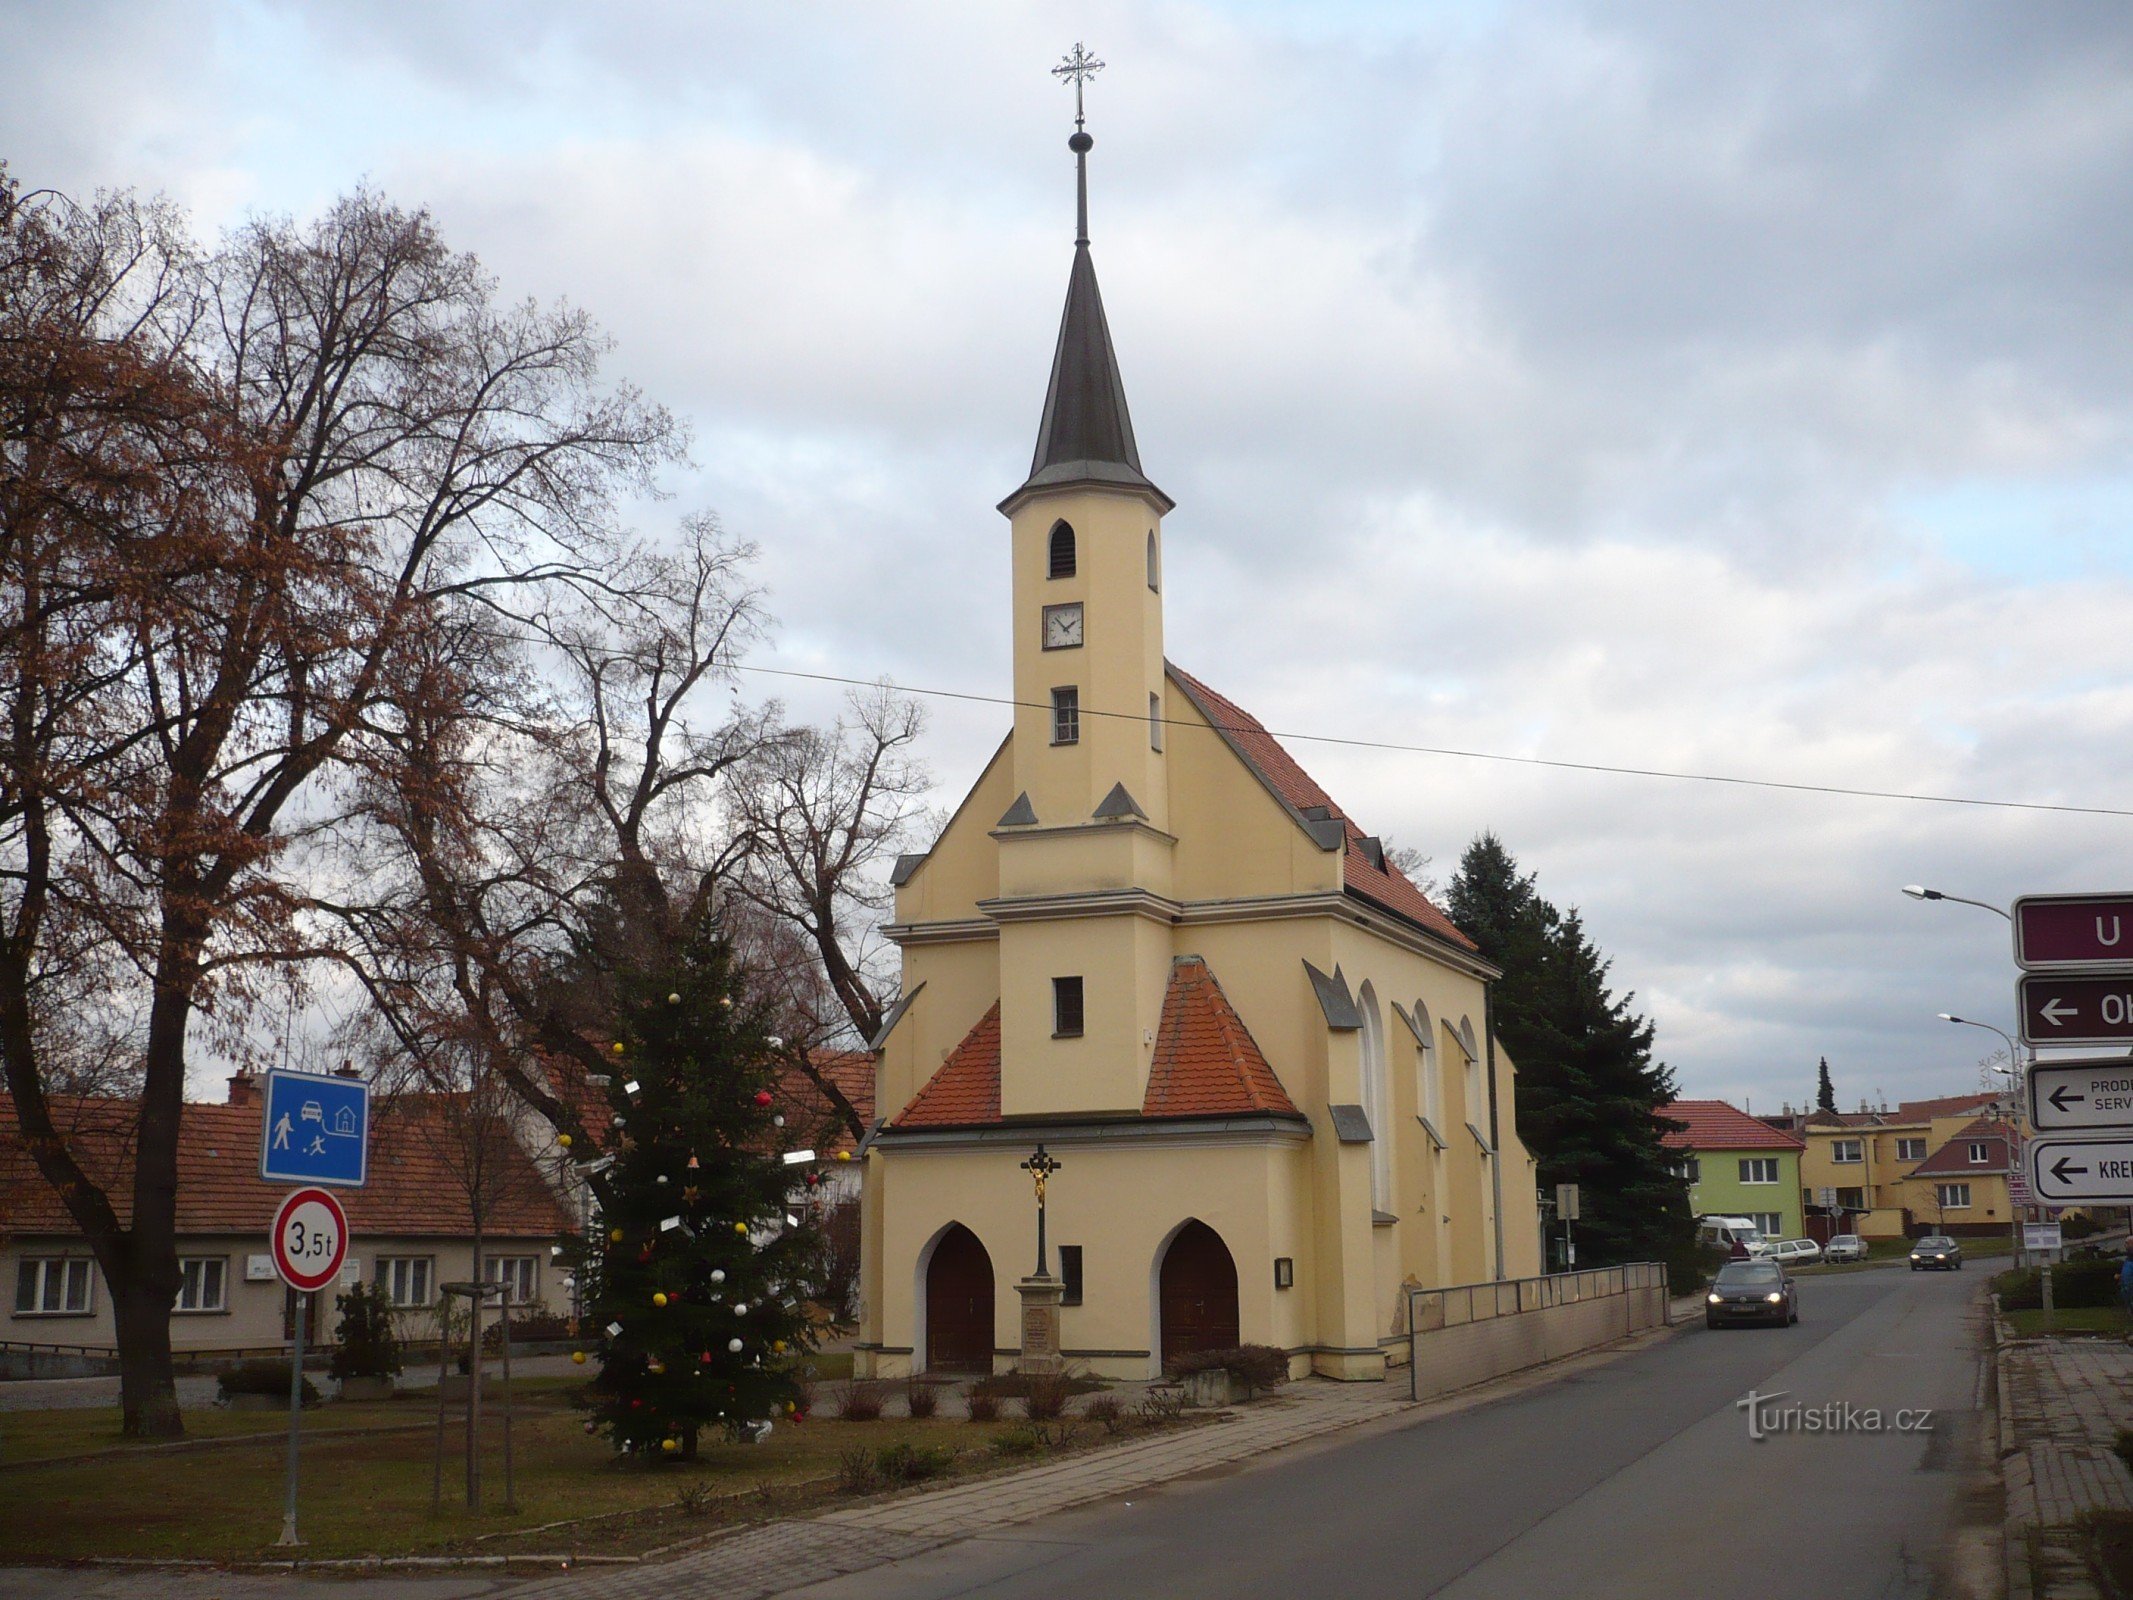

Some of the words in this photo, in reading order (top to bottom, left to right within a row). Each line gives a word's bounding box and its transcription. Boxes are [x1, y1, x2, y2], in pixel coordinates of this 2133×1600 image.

[2095, 915, 2121, 947] U
[2091, 1079, 2133, 1093] PROD
[2099, 1160, 2133, 1179] KRE
